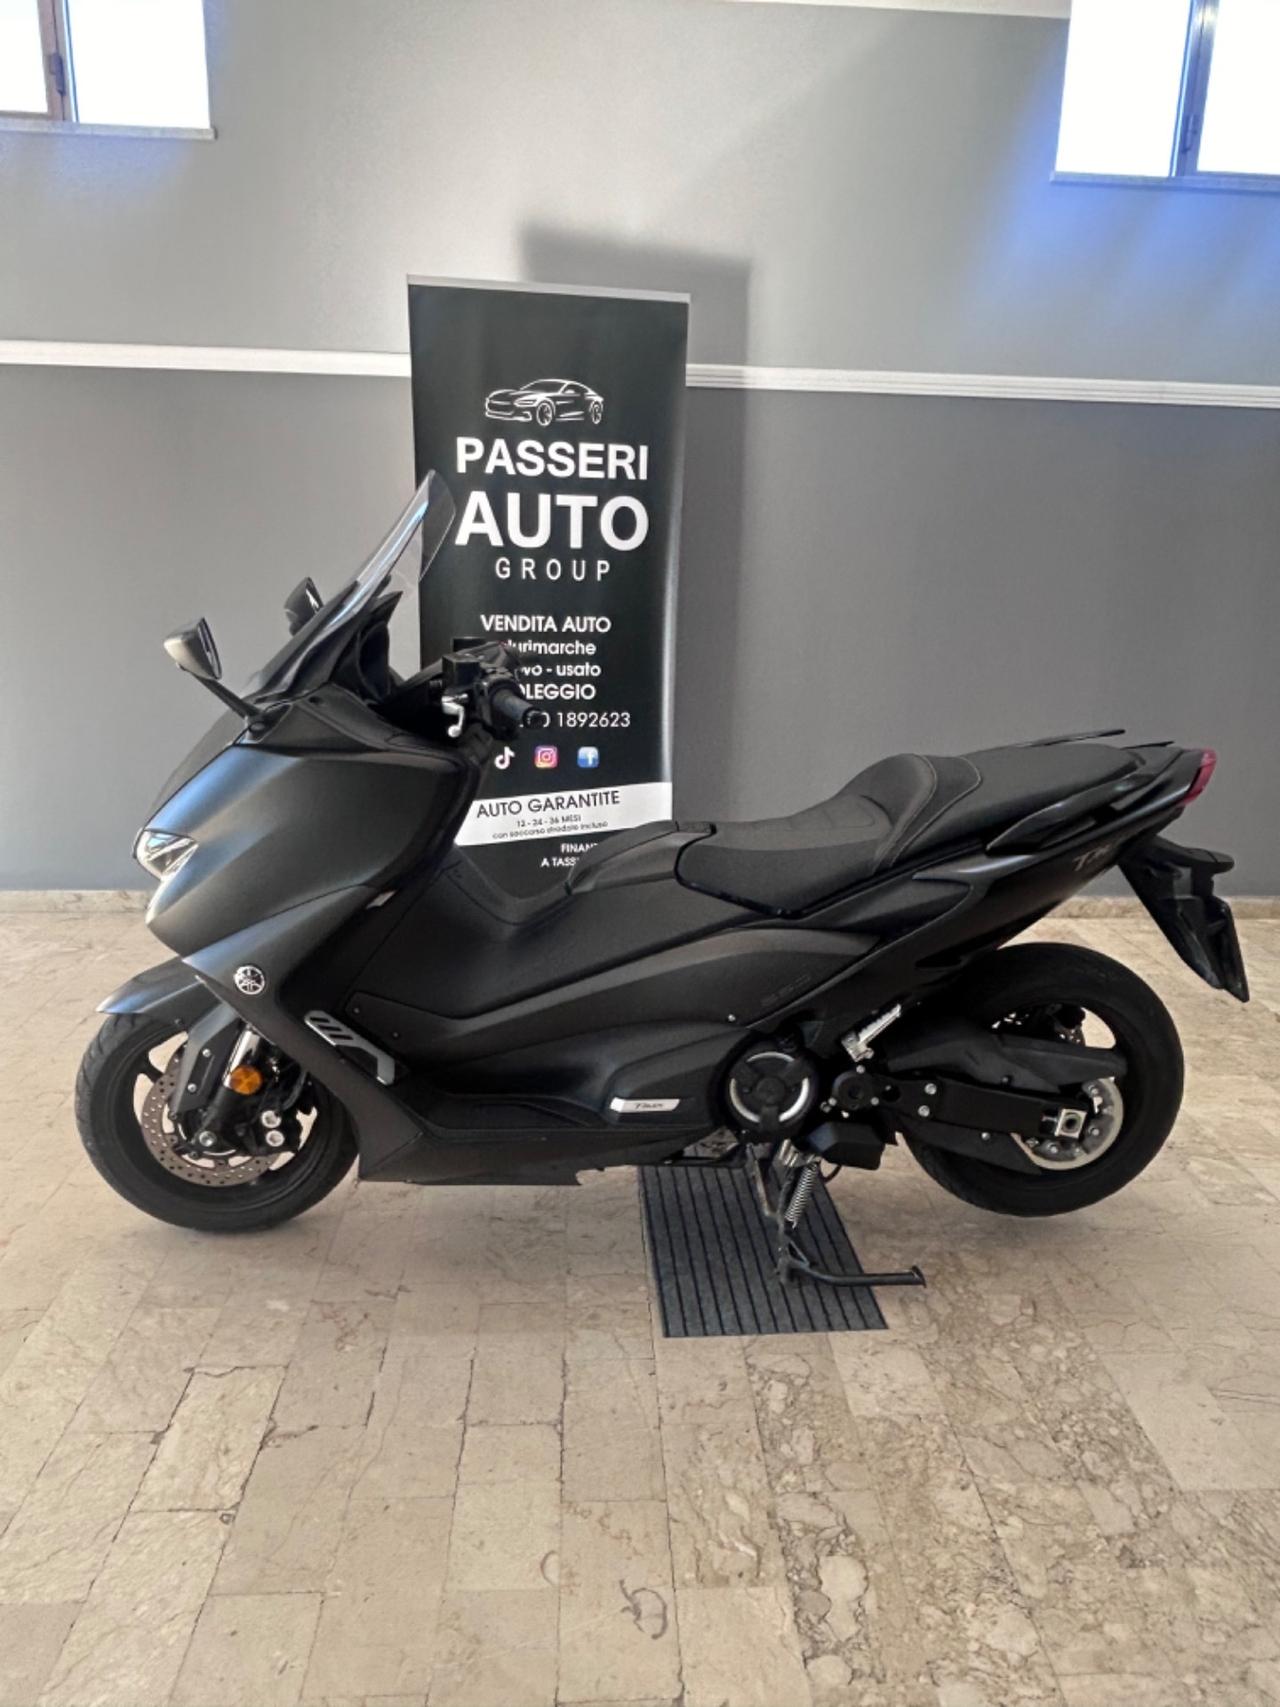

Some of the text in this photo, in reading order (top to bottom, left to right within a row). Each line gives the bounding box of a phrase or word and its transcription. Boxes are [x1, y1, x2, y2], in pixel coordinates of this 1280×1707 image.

[456, 436, 649, 480] PASSERI
[455, 490, 649, 551] AUTO
[495, 557, 610, 581] GROUP
[480, 614, 611, 632] VENDITA AUTO
[556, 662, 602, 677] usato
[519, 683, 596, 700] LEGGIO
[557, 712, 631, 728] 1892623
[476, 790, 620, 818] AUTO GARANTITE
[562, 814, 582, 823] MESI
[540, 856, 579, 867] A TASS
